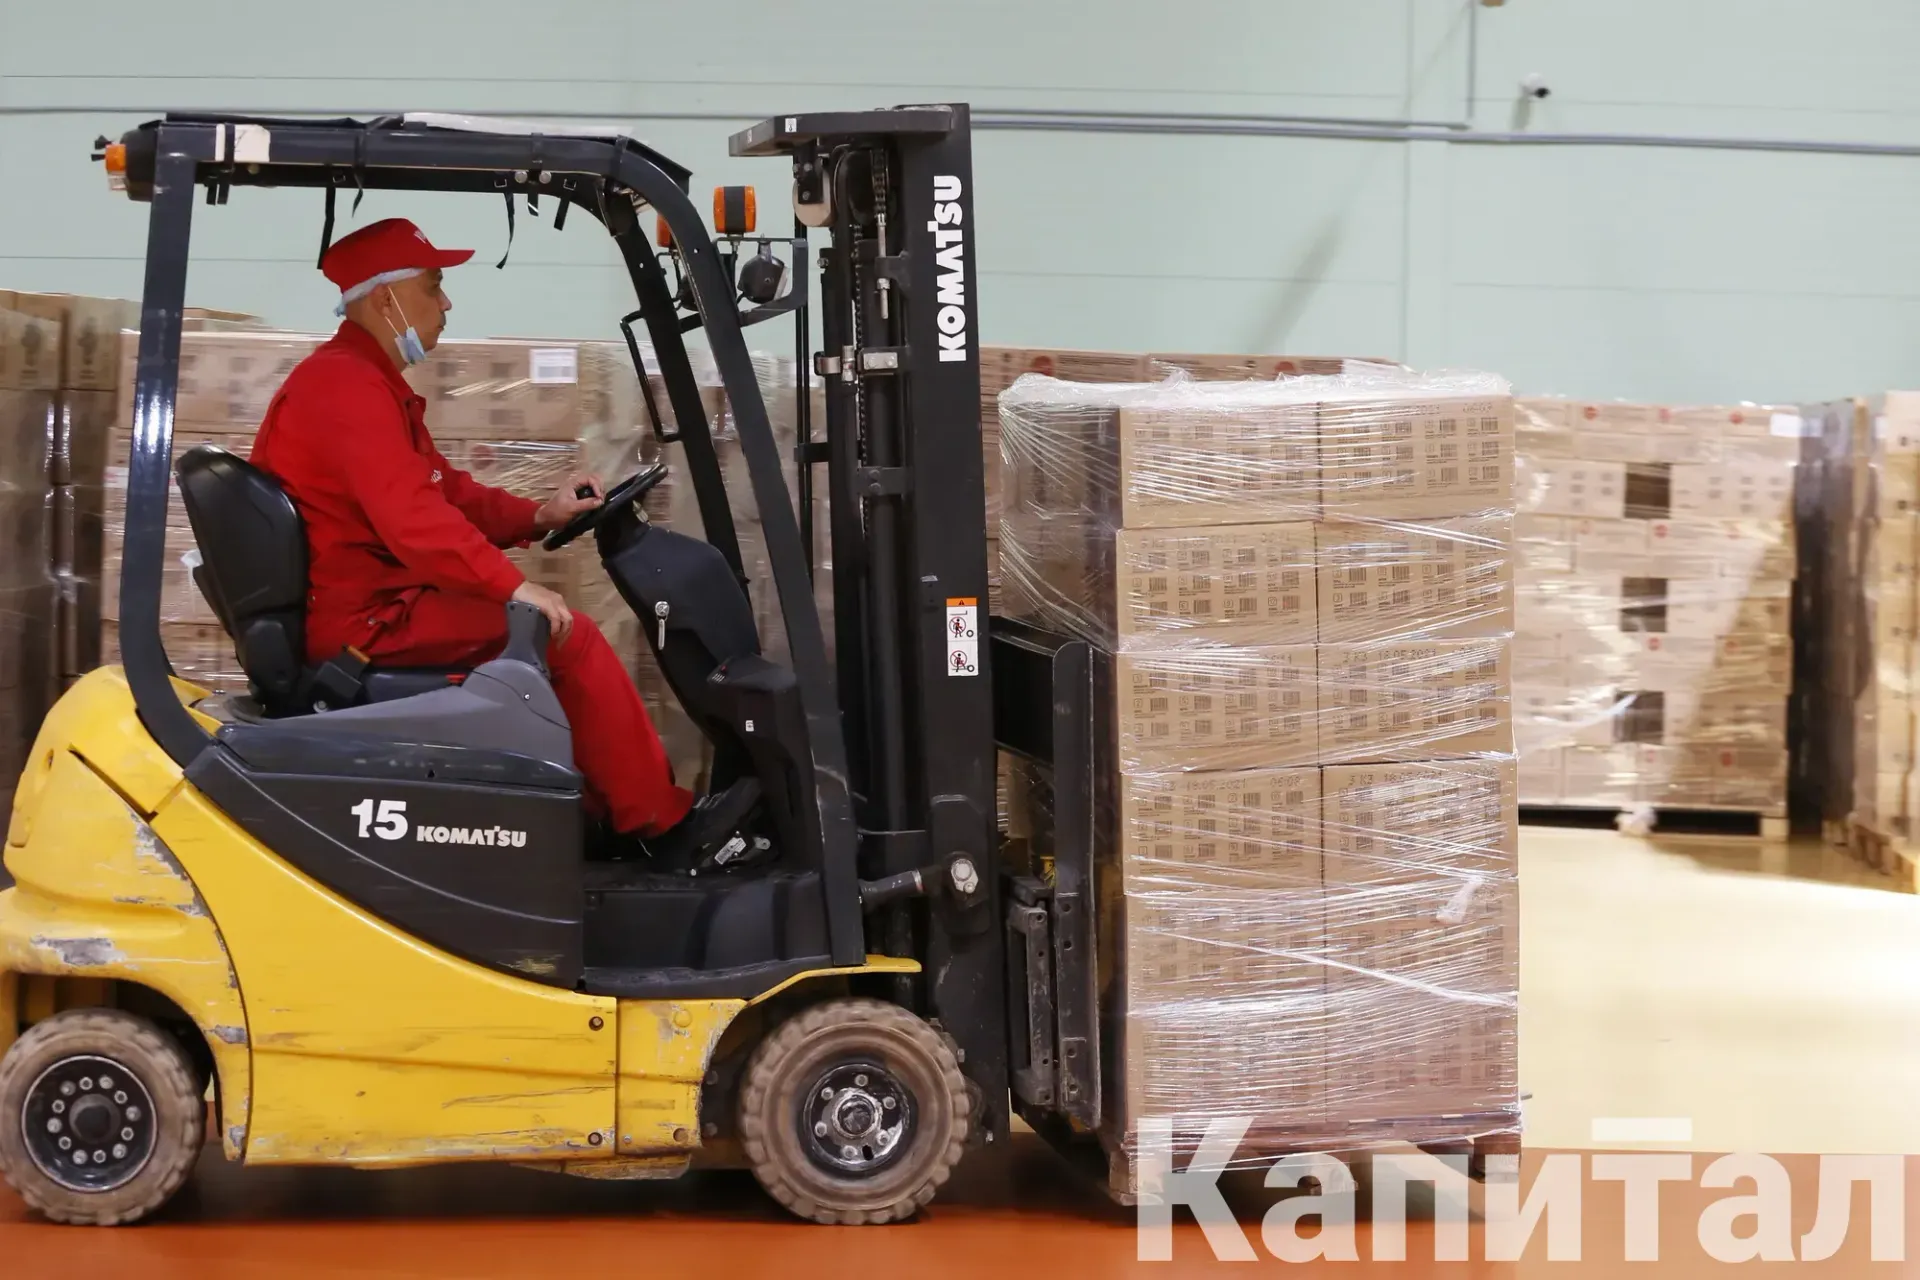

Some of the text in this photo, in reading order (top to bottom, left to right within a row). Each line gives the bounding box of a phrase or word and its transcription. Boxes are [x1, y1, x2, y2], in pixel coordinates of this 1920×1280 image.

[927, 175, 966, 362] KOMATSU
[351, 799, 526, 848] 15 KOMATSU
